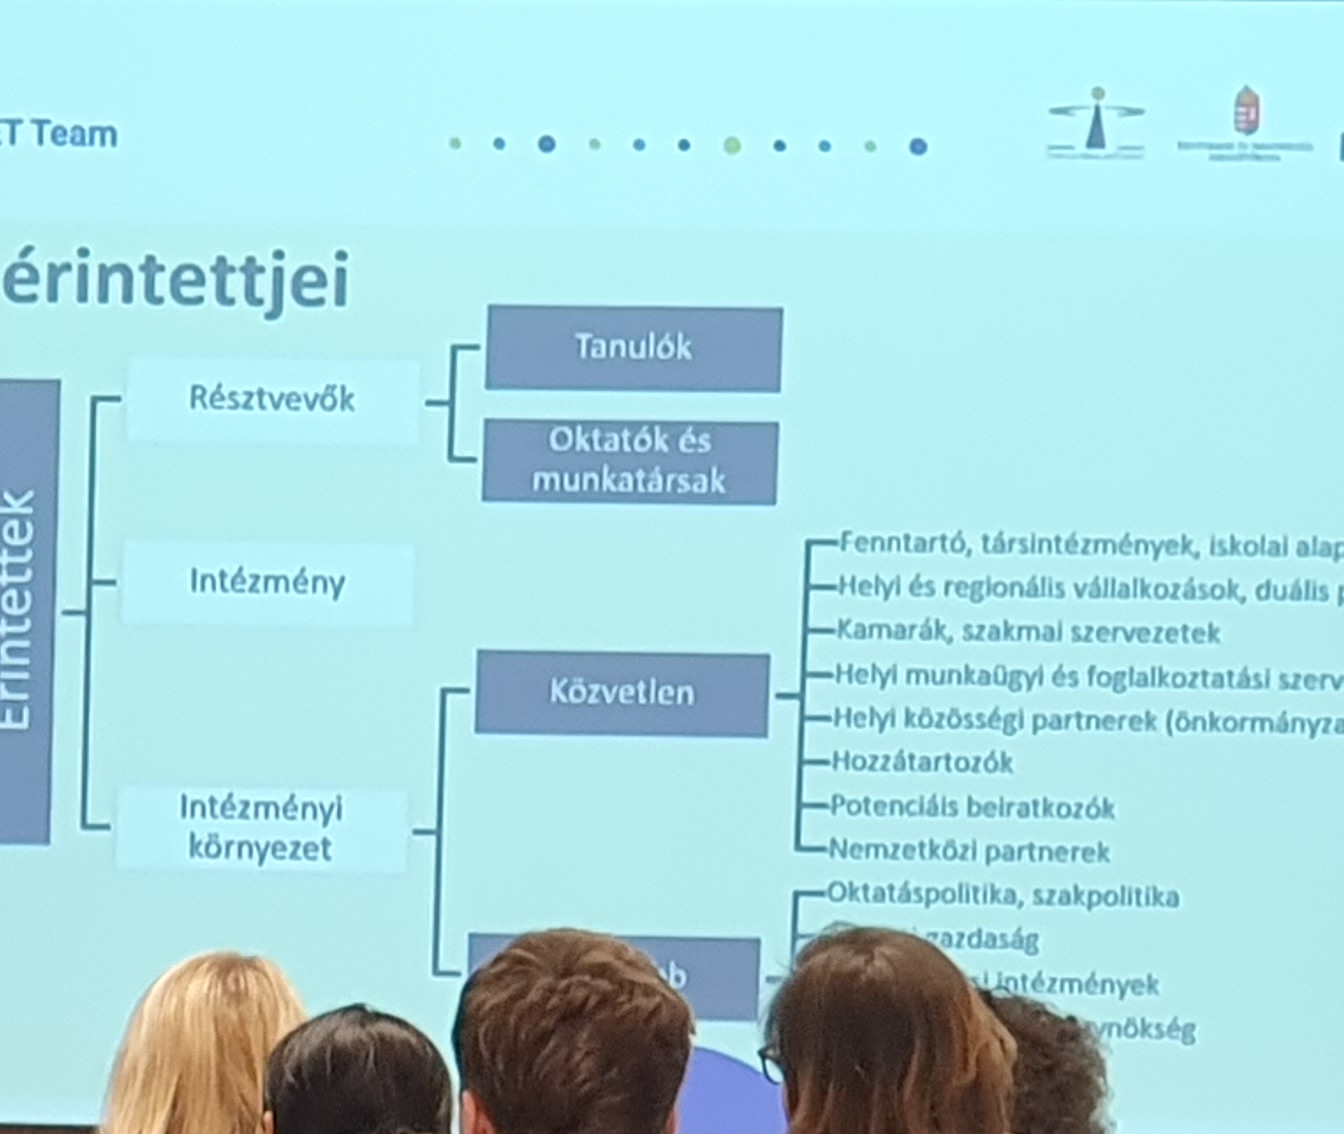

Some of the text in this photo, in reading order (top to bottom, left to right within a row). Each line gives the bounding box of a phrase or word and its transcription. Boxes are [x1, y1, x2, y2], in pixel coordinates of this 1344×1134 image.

[29, 118, 118, 148] Team
[2, 244, 350, 321] érintettjei
[574, 330, 693, 361] Tanulók
[189, 381, 356, 413] Résztvevők
[548, 424, 712, 454] Oktatók és
[532, 463, 727, 495] munkatársak
[840, 528, 973, 559] Fenntartó,
[981, 530, 1201, 562] társintézmények,
[1209, 533, 1289, 558] iskolai
[189, 564, 347, 602] Intézmény
[839, 573, 902, 601] Helyi
[908, 572, 936, 598] és
[942, 574, 1067, 605] regionális
[1073, 575, 1248, 606] vállalkozások,
[1255, 578, 1330, 602] duális
[838, 617, 1222, 646] Kamarák, szakmai szervezetek
[549, 676, 695, 707] Közvetlen
[835, 661, 1344, 695] Helyi munkaügyi és foglalkoztatási szerv
[833, 704, 897, 734] Helyi
[903, 706, 1026, 737] közösségi
[1031, 709, 1158, 737] partnerek
[831, 748, 1014, 775] Hozzátartozók
[179, 790, 344, 829] Intézményi
[830, 792, 1116, 821] Potenciális beiratkozók
[188, 830, 333, 868] környezet
[828, 836, 1112, 867] Nemzetközi partnerek
[826, 880, 1181, 912] Oktatáspolitika, szakpolitika
[996, 970, 1160, 1000] intézmények
